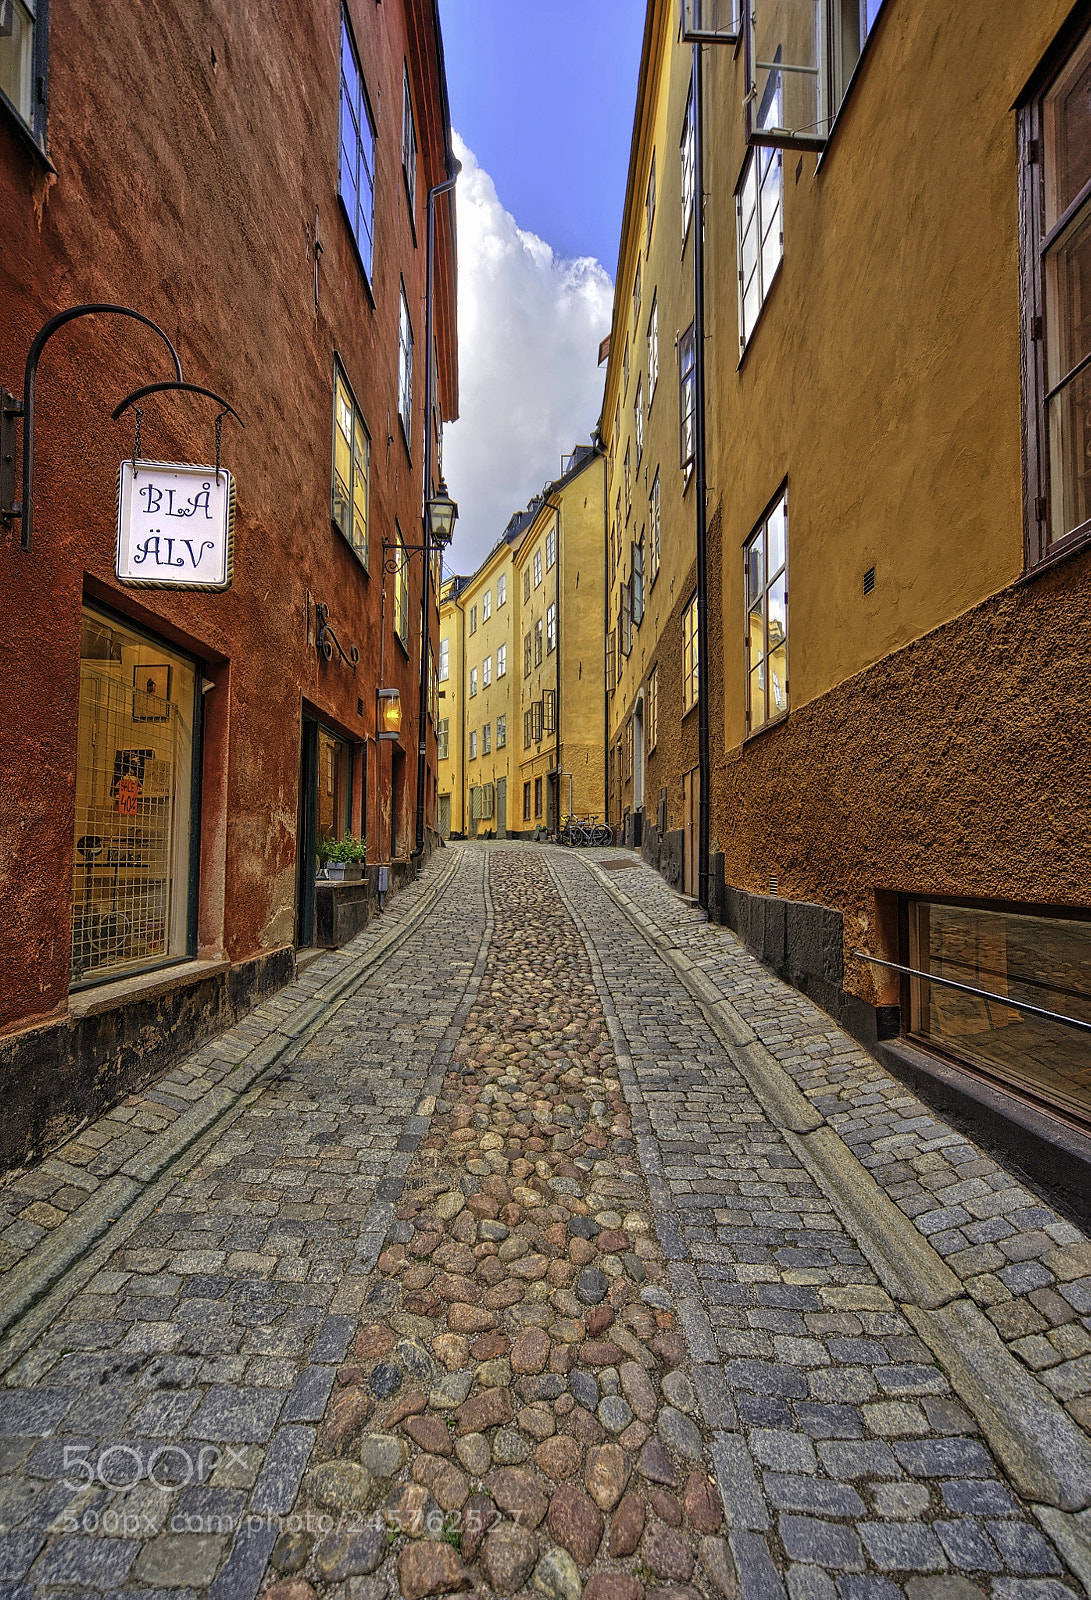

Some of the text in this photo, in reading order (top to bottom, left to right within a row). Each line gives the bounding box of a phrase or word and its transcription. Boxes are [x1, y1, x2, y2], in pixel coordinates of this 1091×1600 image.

[139, 482, 213, 519] BLÅ
[133, 528, 214, 568] ÄLV
[120, 794, 137, 813] 40%
